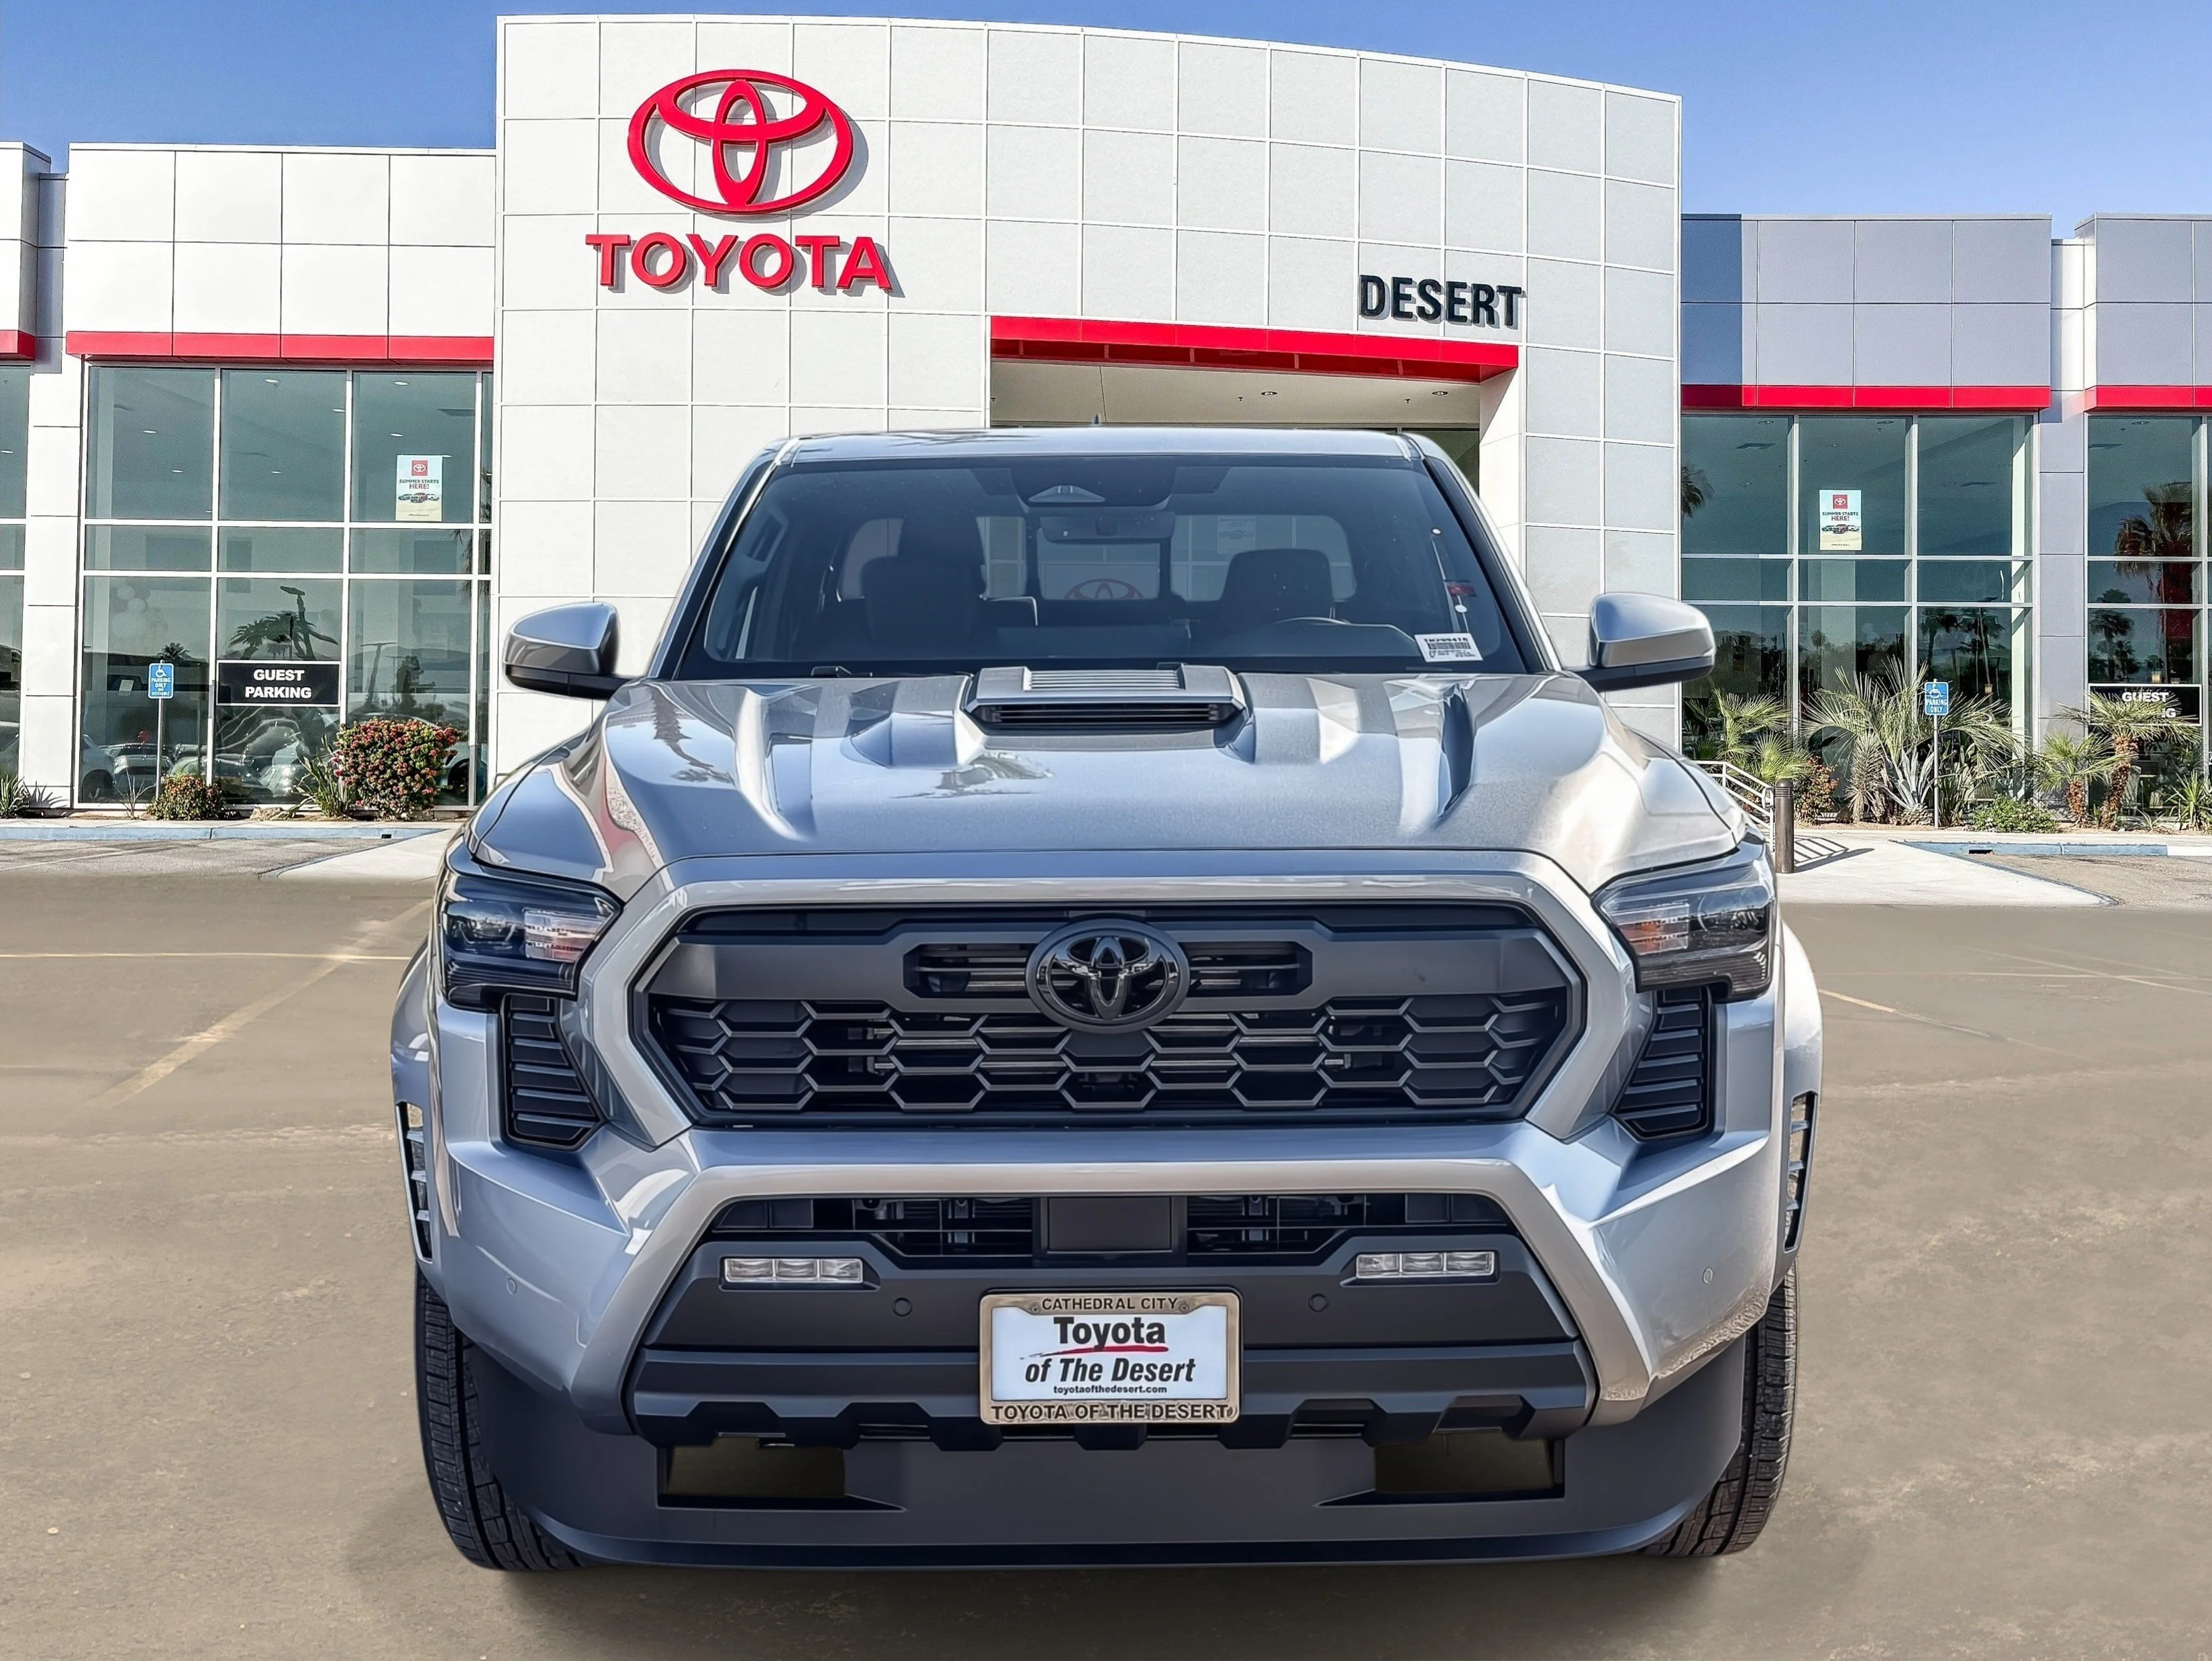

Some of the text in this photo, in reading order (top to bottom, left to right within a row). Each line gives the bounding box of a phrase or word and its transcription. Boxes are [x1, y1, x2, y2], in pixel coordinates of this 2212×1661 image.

[585, 232, 893, 291] TOYOTA
[1359, 274, 1522, 327] DESERT
[253, 668, 305, 681] GUEST
[245, 687, 311, 699] PARKING
[2121, 692, 2169, 703] GUEST
[1042, 1298, 1179, 1310] CATHEDRAL CITY
[1054, 1316, 1166, 1352] Toyota
[1025, 1358, 1196, 1383] of The Desert
[1053, 1385, 1168, 1395] toyotaofthedesert.com
[991, 1404, 1229, 1420] TOYOTA OF THE DESERT
